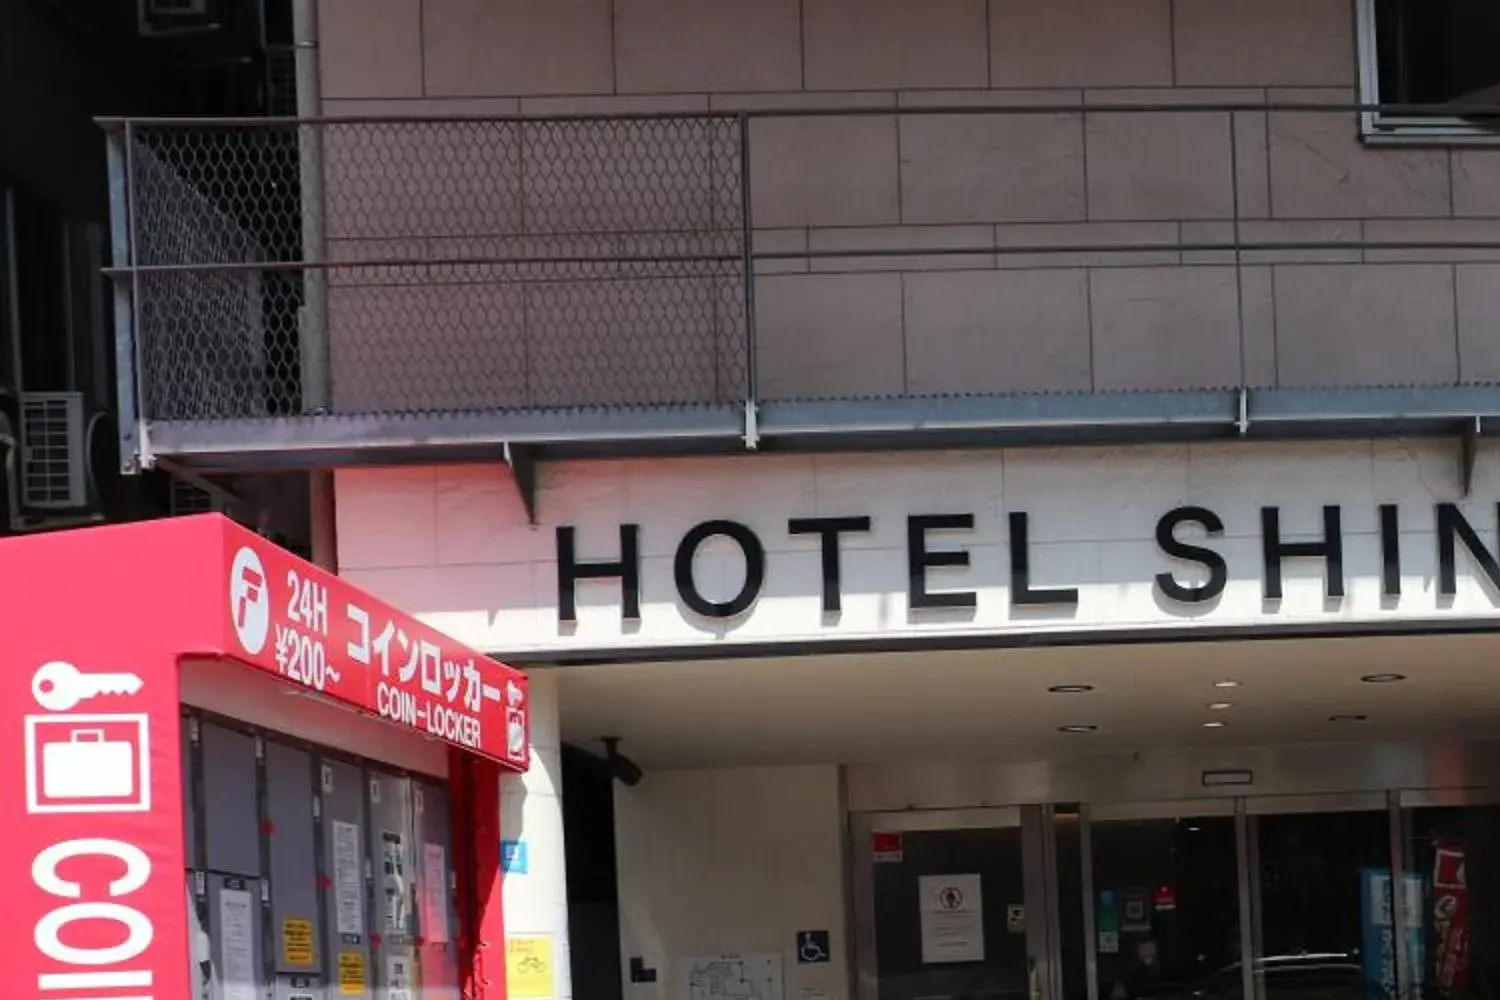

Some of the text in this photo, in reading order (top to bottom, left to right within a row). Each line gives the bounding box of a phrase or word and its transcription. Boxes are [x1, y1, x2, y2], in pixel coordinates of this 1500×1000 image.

[287, 569, 328, 636] 24H
[555, 511, 1078, 621] HOTEL
[347, 603, 500, 712] コインロッカー
[377, 681, 481, 749] COIN-LOCKER
